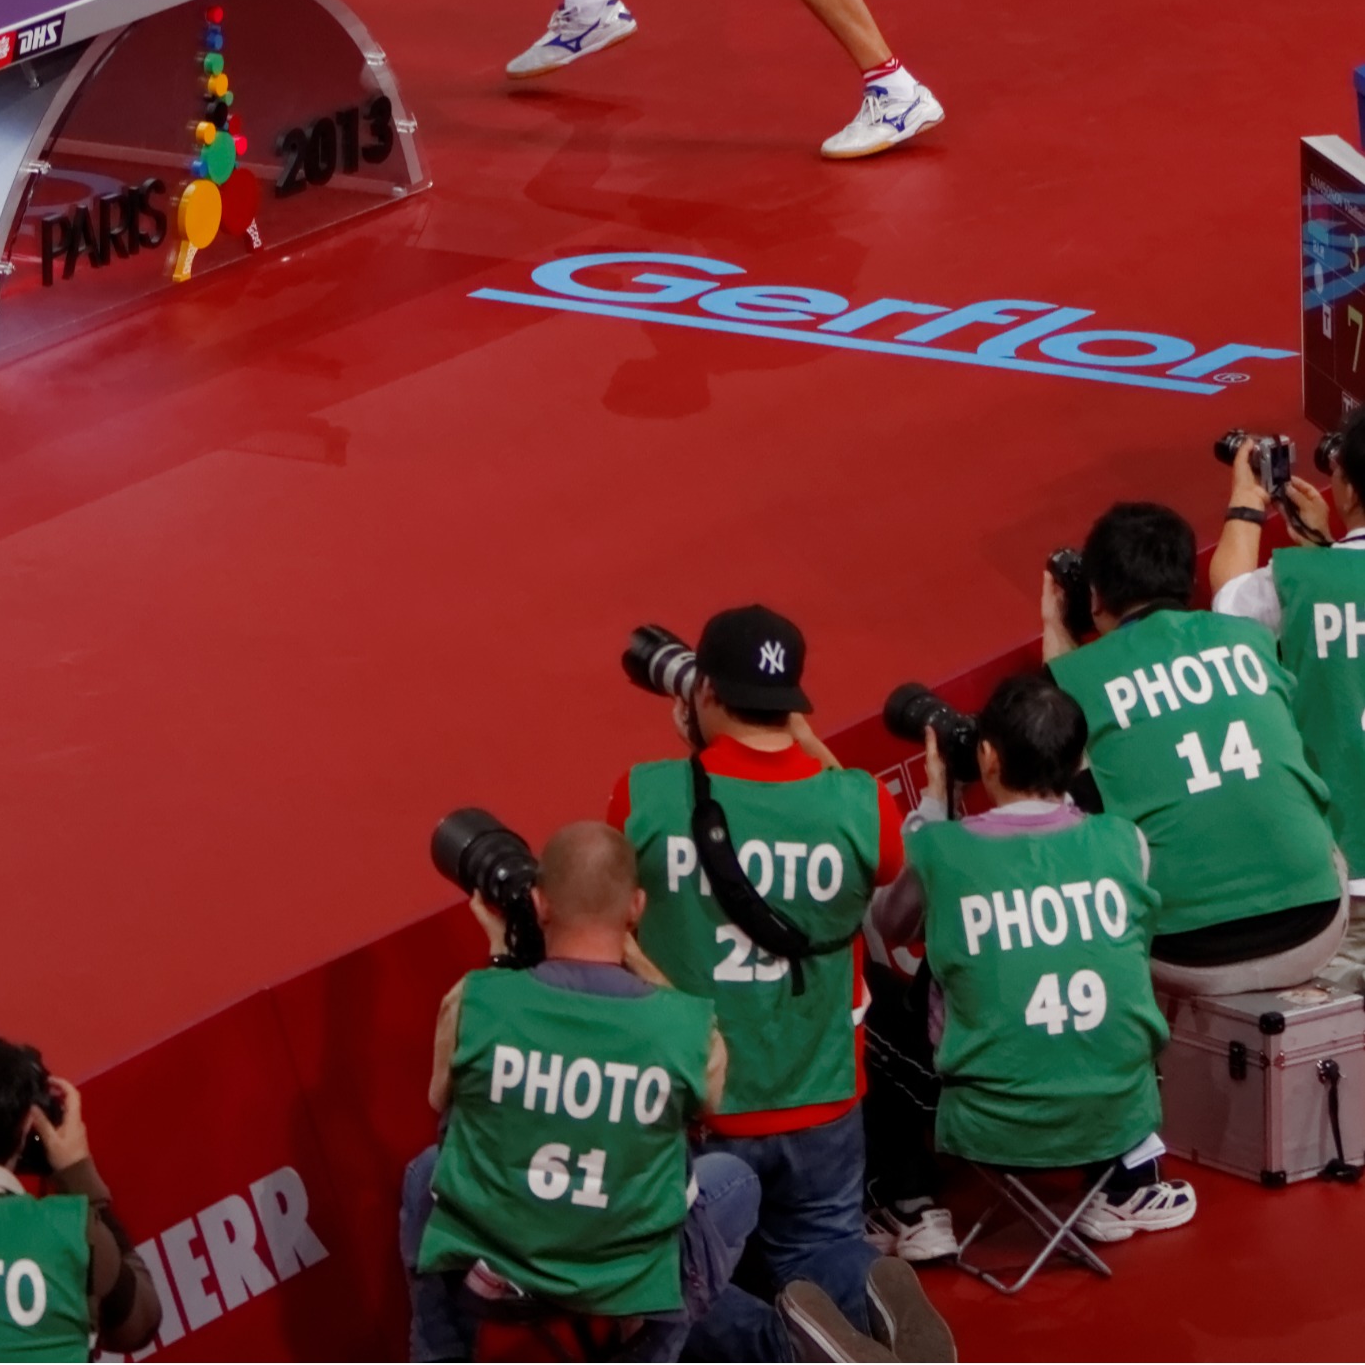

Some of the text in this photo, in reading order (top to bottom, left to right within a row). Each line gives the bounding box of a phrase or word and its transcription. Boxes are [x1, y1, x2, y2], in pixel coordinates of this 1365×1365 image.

[18, 19, 62, 55] DHS
[41, 95, 395, 286] PARIS 2013
[531, 251, 1301, 380] Gerflor
[1105, 642, 1269, 728] PHOTO
[1175, 720, 1262, 794] 14
[667, 835, 843, 902] POTO
[960, 876, 1128, 957] PHOTO
[1024, 969, 1107, 1035] 49
[488, 1046, 671, 1125] PHOTO
[527, 1142, 609, 1209] 61
